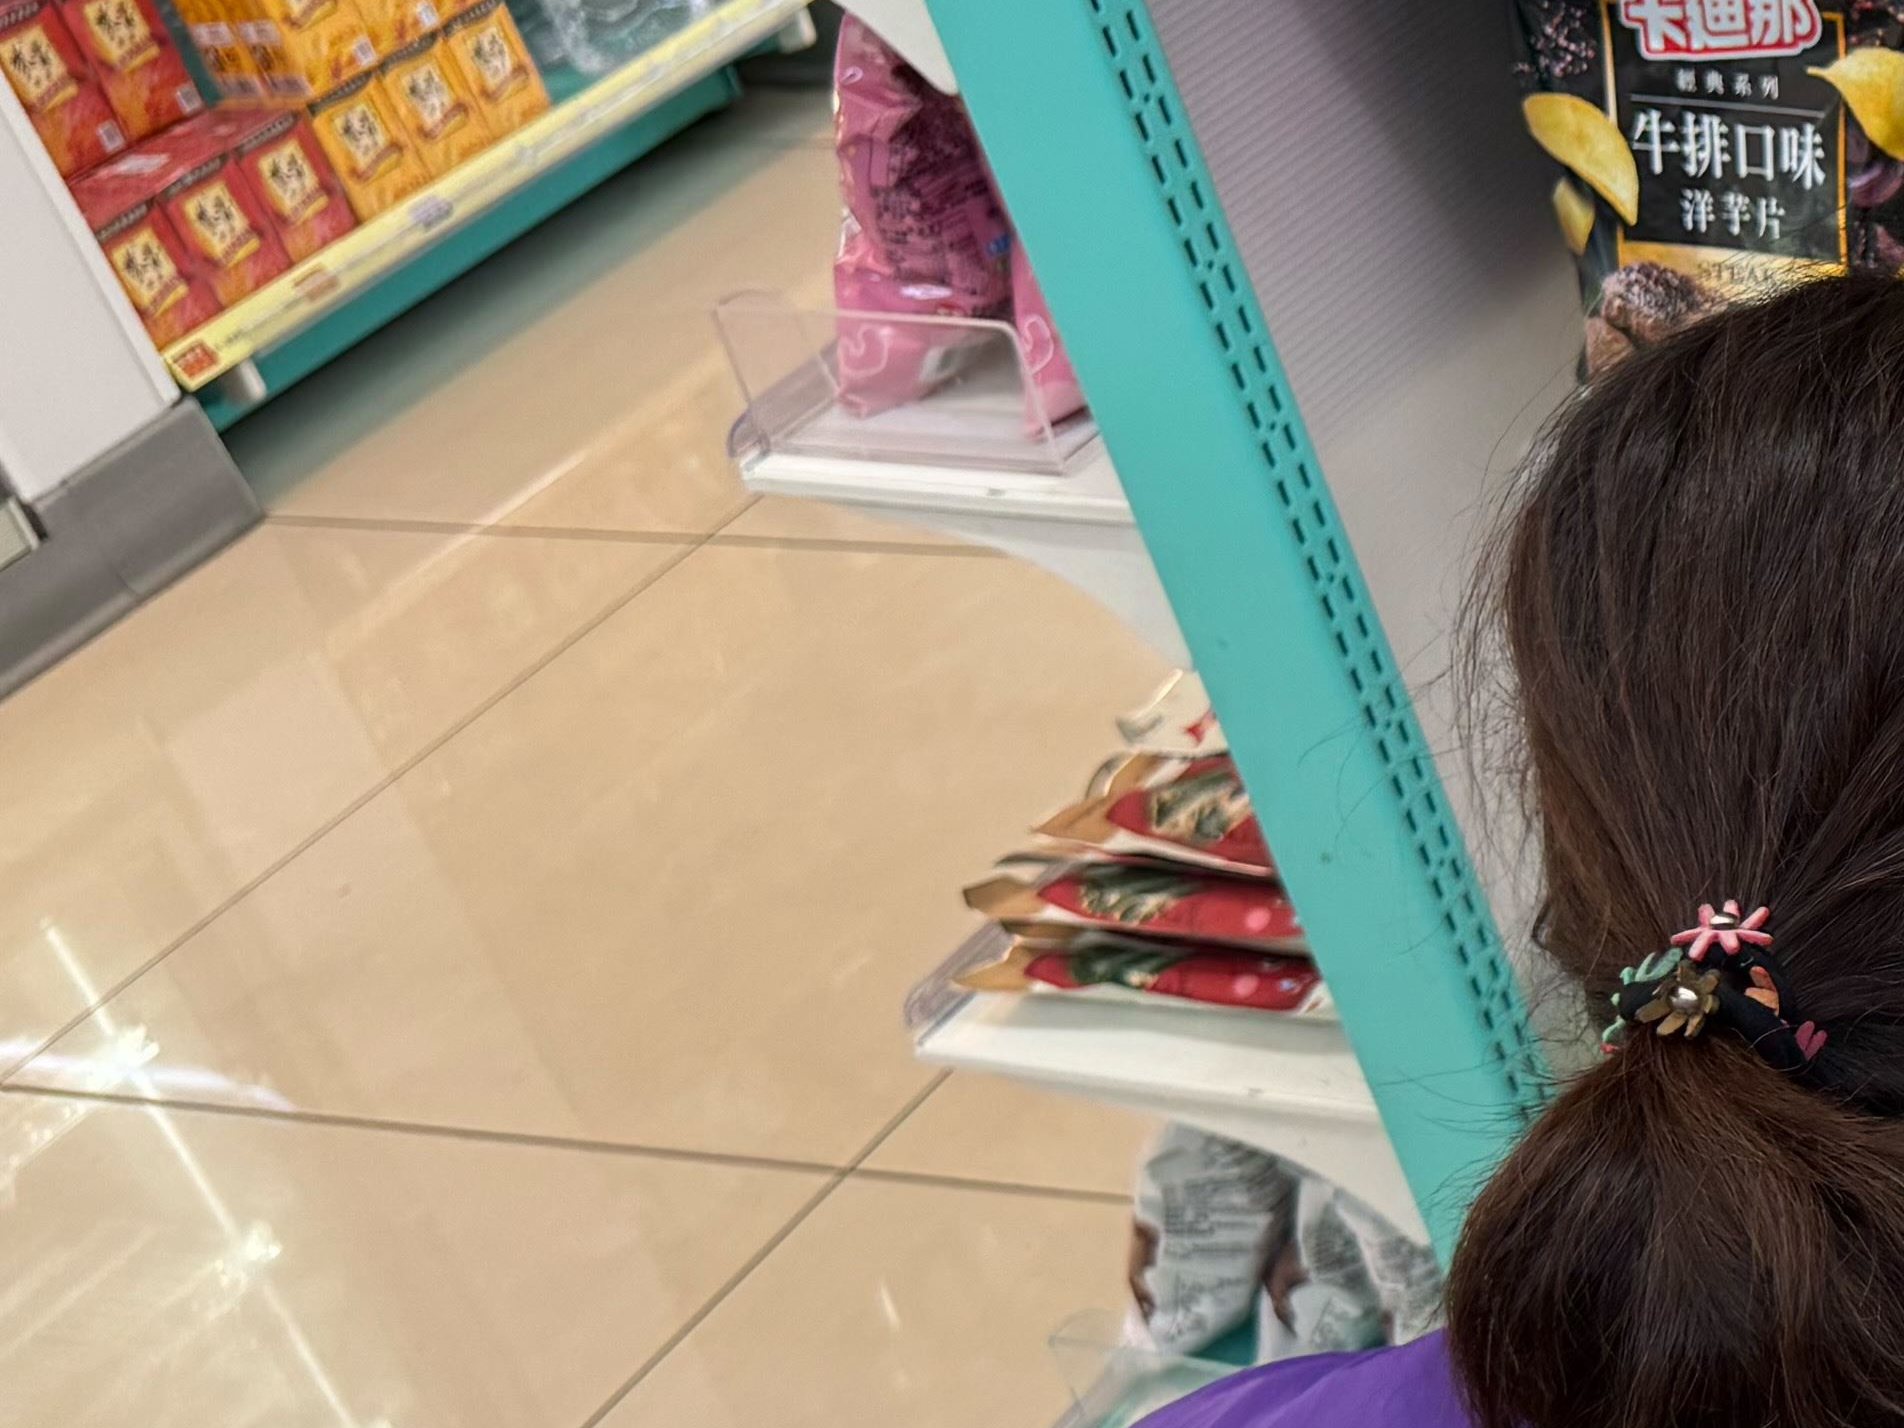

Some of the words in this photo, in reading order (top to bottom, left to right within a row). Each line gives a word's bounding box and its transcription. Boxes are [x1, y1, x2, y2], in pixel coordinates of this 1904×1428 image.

[1675, 68, 1780, 100] 經典系列
[1632, 110, 1827, 190] 牛排口味
[1680, 188, 1787, 240] 洋芋片
